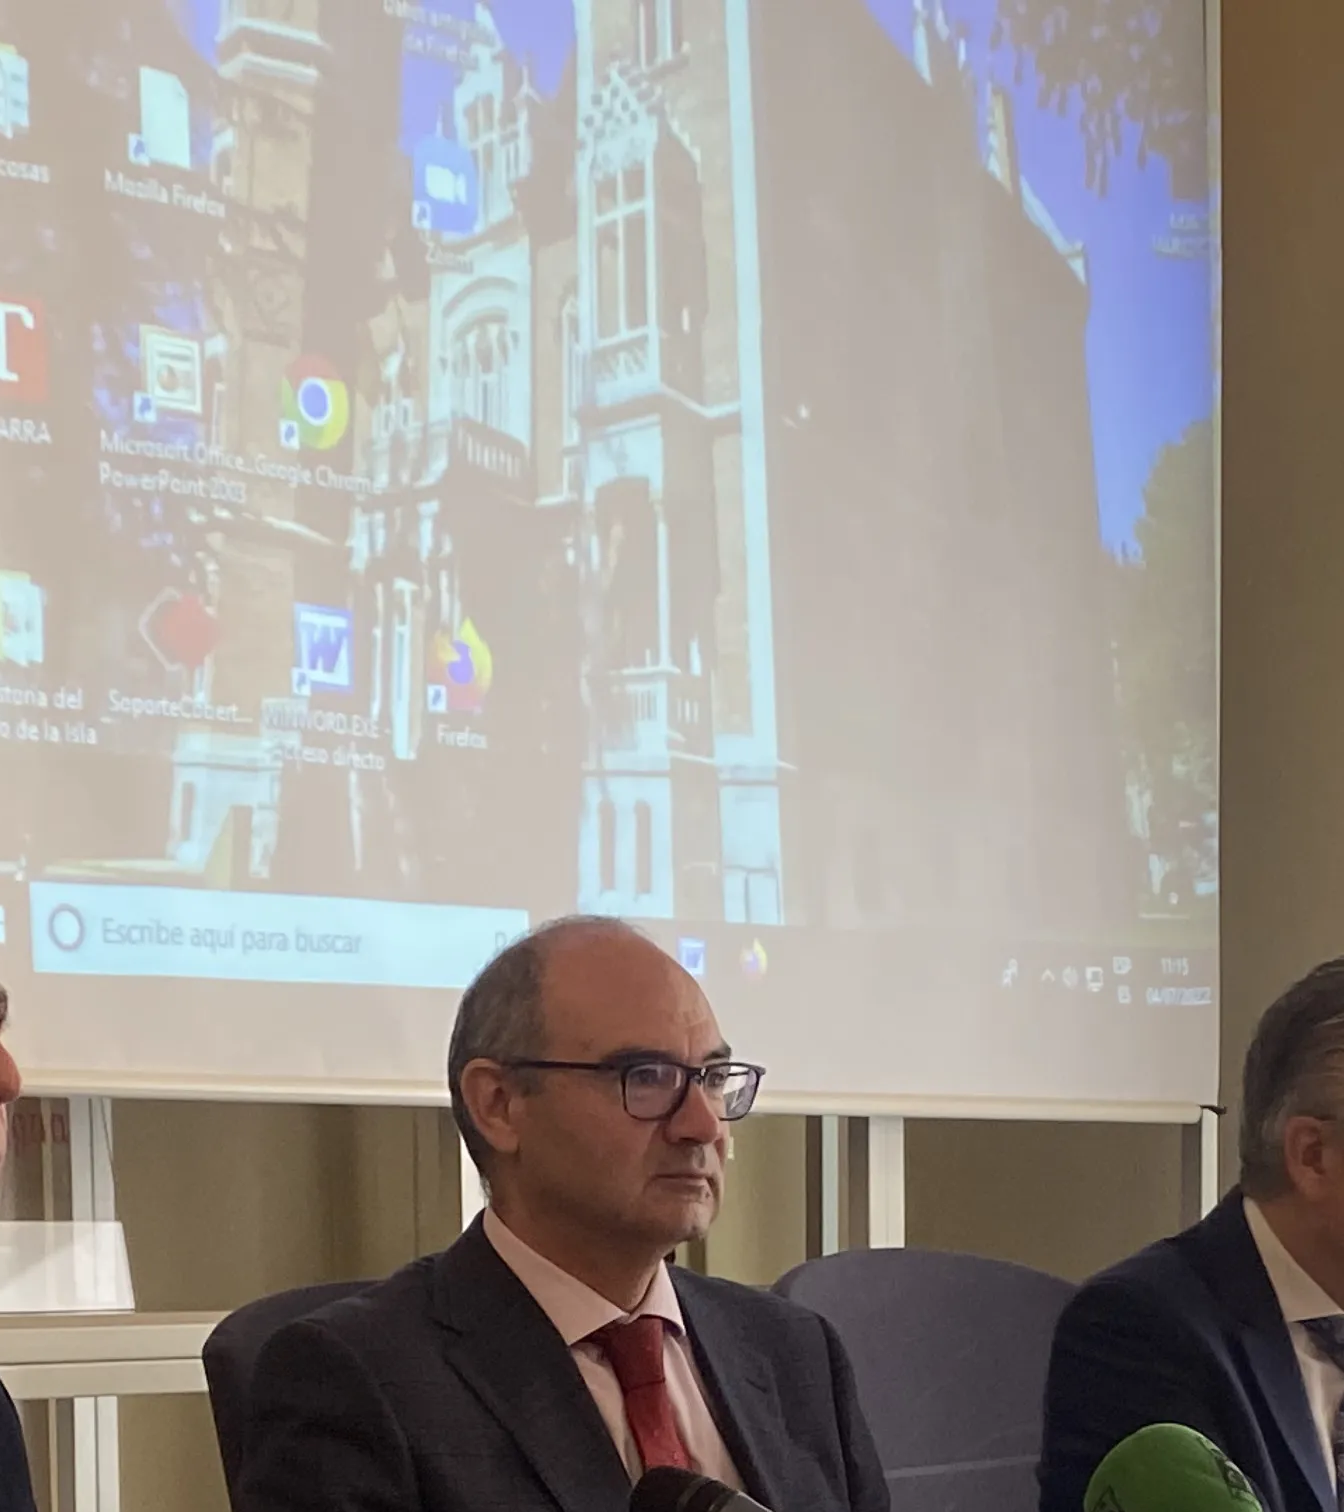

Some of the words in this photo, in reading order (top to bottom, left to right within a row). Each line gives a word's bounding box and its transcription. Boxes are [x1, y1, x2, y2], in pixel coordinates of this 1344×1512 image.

[105, 166, 169, 203] Mozilla
[100, 428, 193, 462] Microsoft
[99, 460, 205, 498] PowerPoint
[255, 453, 312, 488] Google
[315, 463, 383, 494] Chrome
[55, 687, 84, 711] del
[16, 718, 40, 742] de
[44, 718, 61, 744] la
[65, 720, 98, 745] Isla
[436, 723, 488, 749] Firefox
[102, 917, 184, 946] Escribe
[190, 923, 235, 951] aquí
[242, 930, 290, 955] para
[295, 932, 362, 955] buscar
